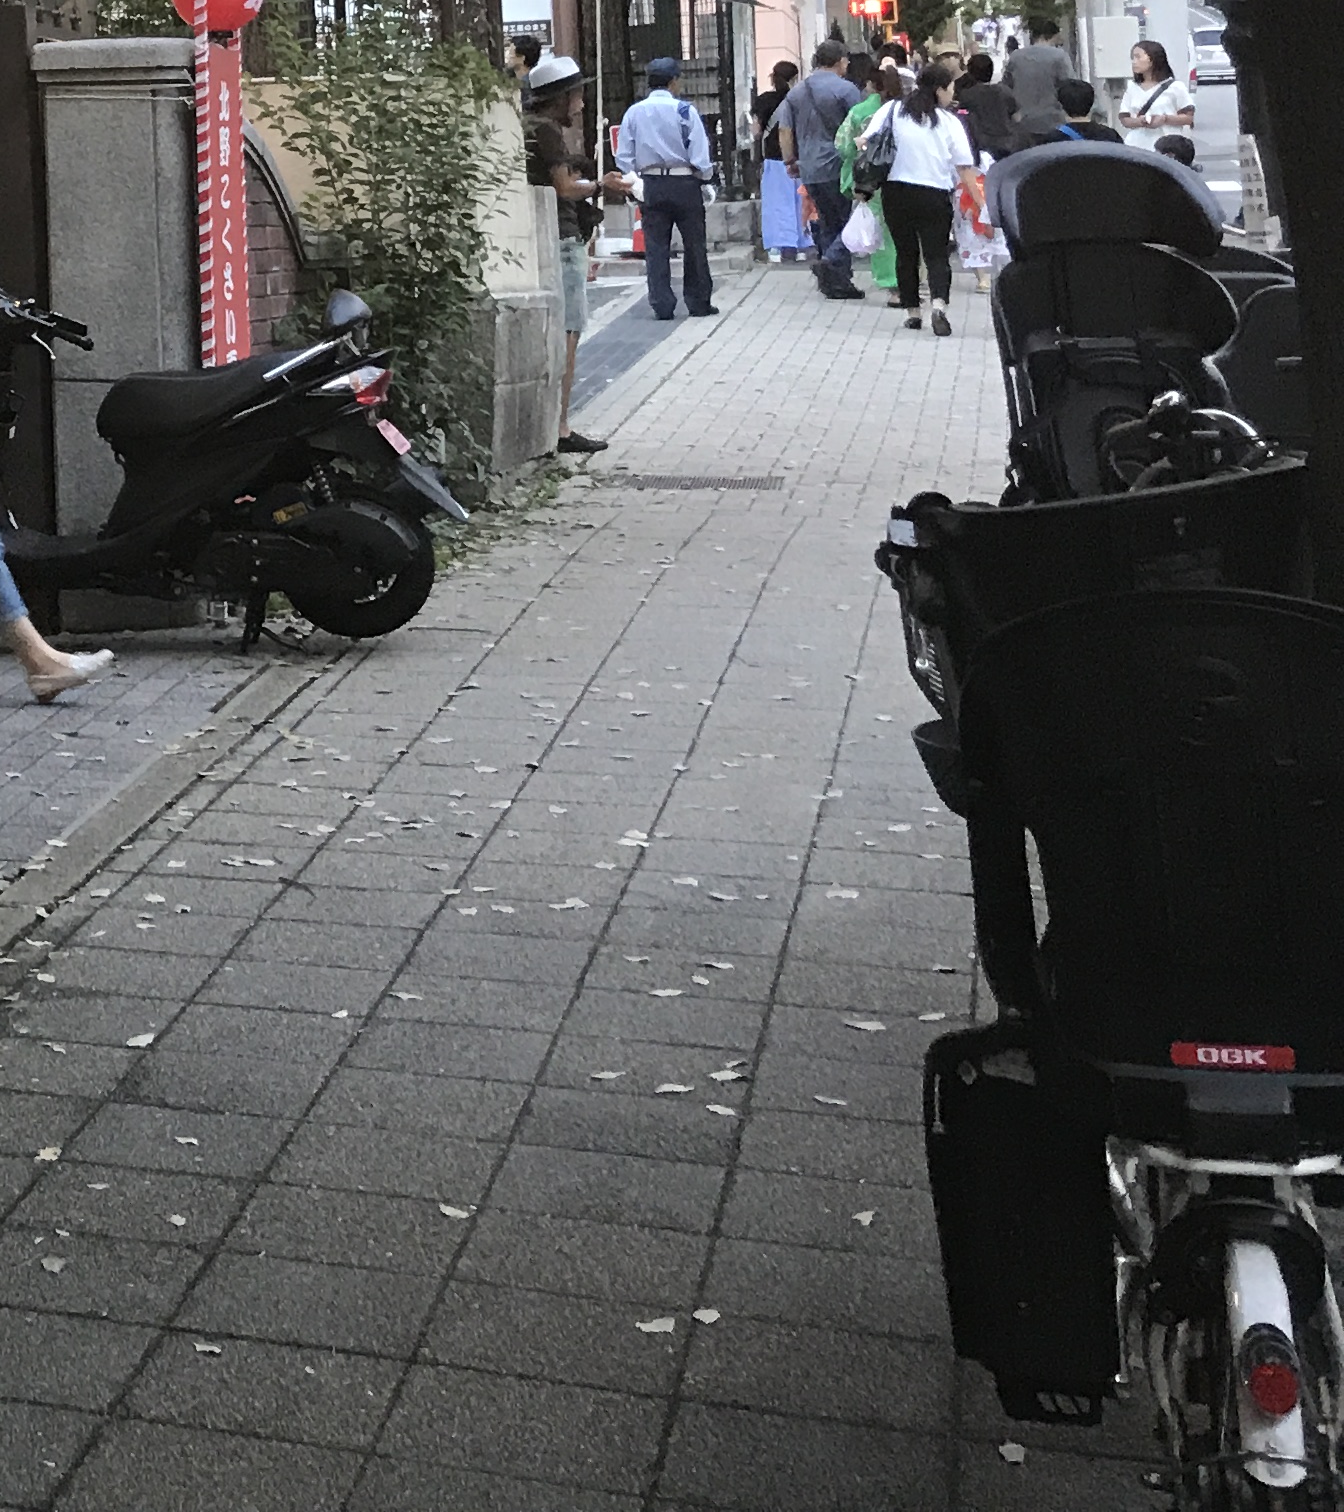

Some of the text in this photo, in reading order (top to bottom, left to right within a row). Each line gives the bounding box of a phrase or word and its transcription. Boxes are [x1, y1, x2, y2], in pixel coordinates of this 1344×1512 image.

[218, 80, 239, 364] 北野こくさい
[1196, 1046, 1267, 1066] OGK
